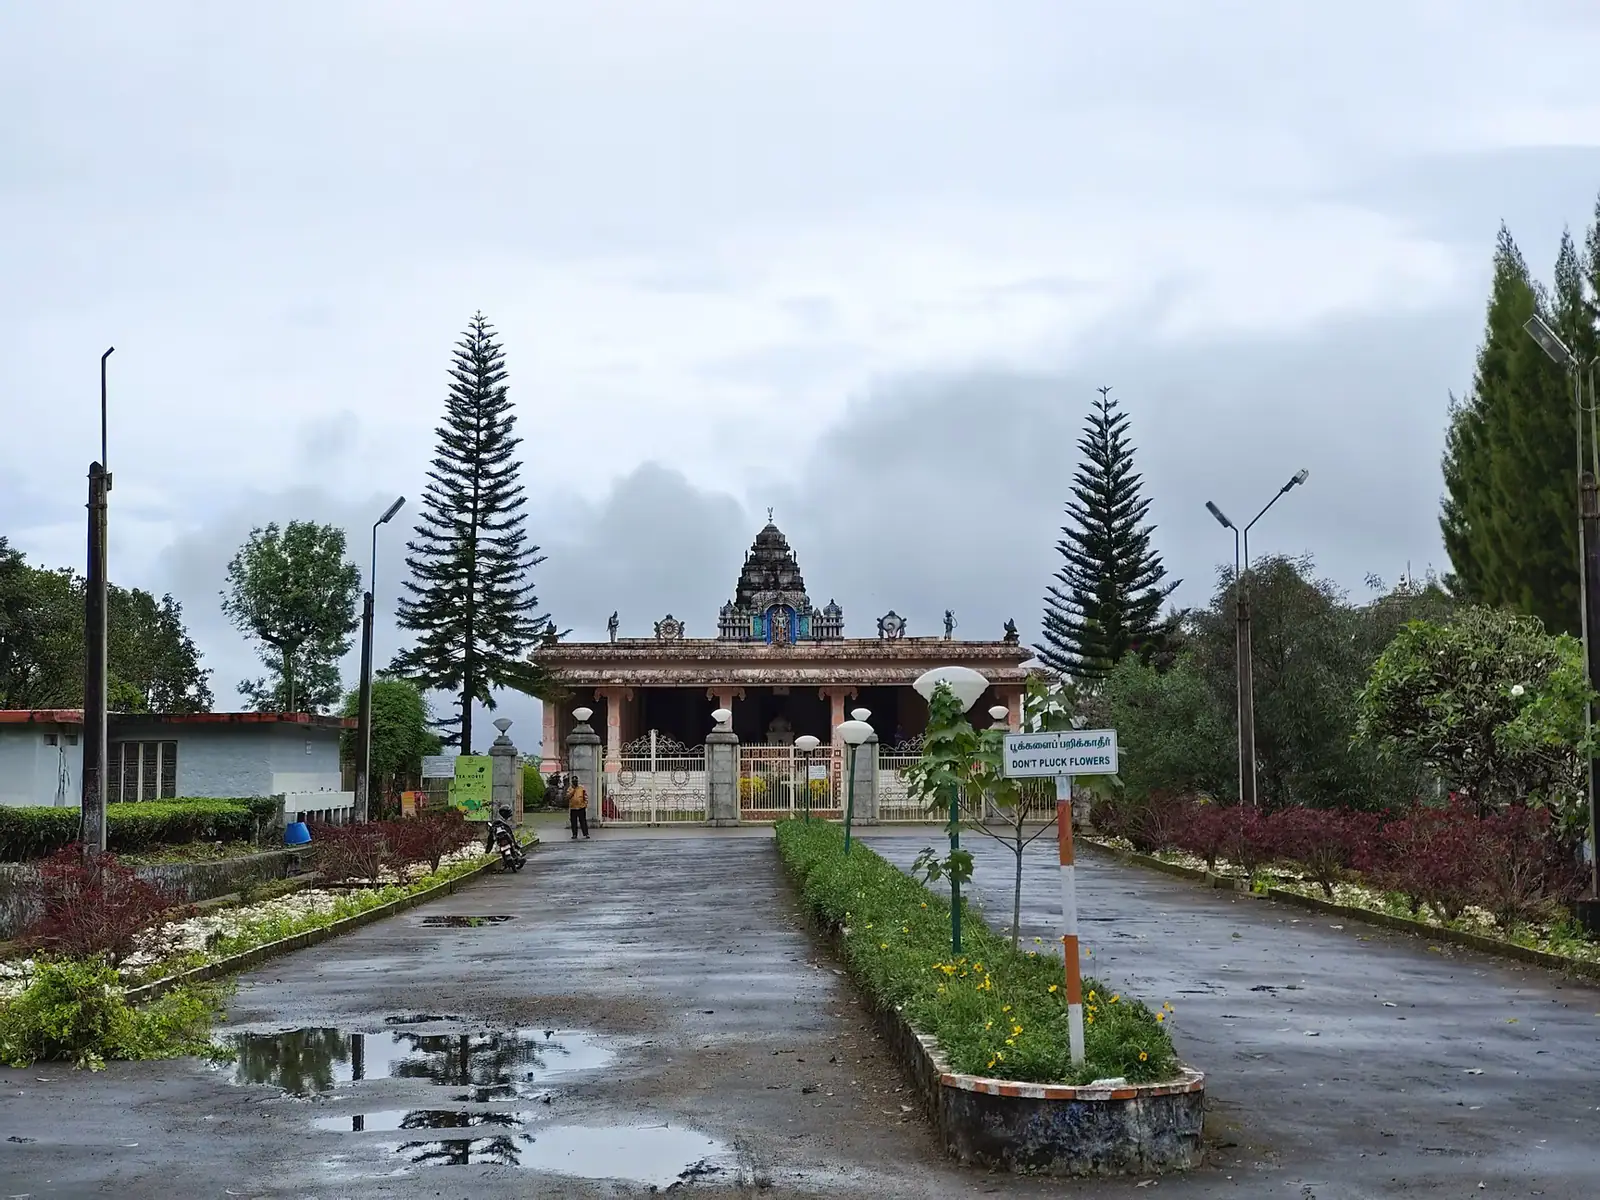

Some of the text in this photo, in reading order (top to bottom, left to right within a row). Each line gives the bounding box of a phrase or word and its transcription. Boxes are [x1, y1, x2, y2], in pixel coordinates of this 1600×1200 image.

[1012, 756, 1110, 768] DON'T PLUCK FLOWERS
